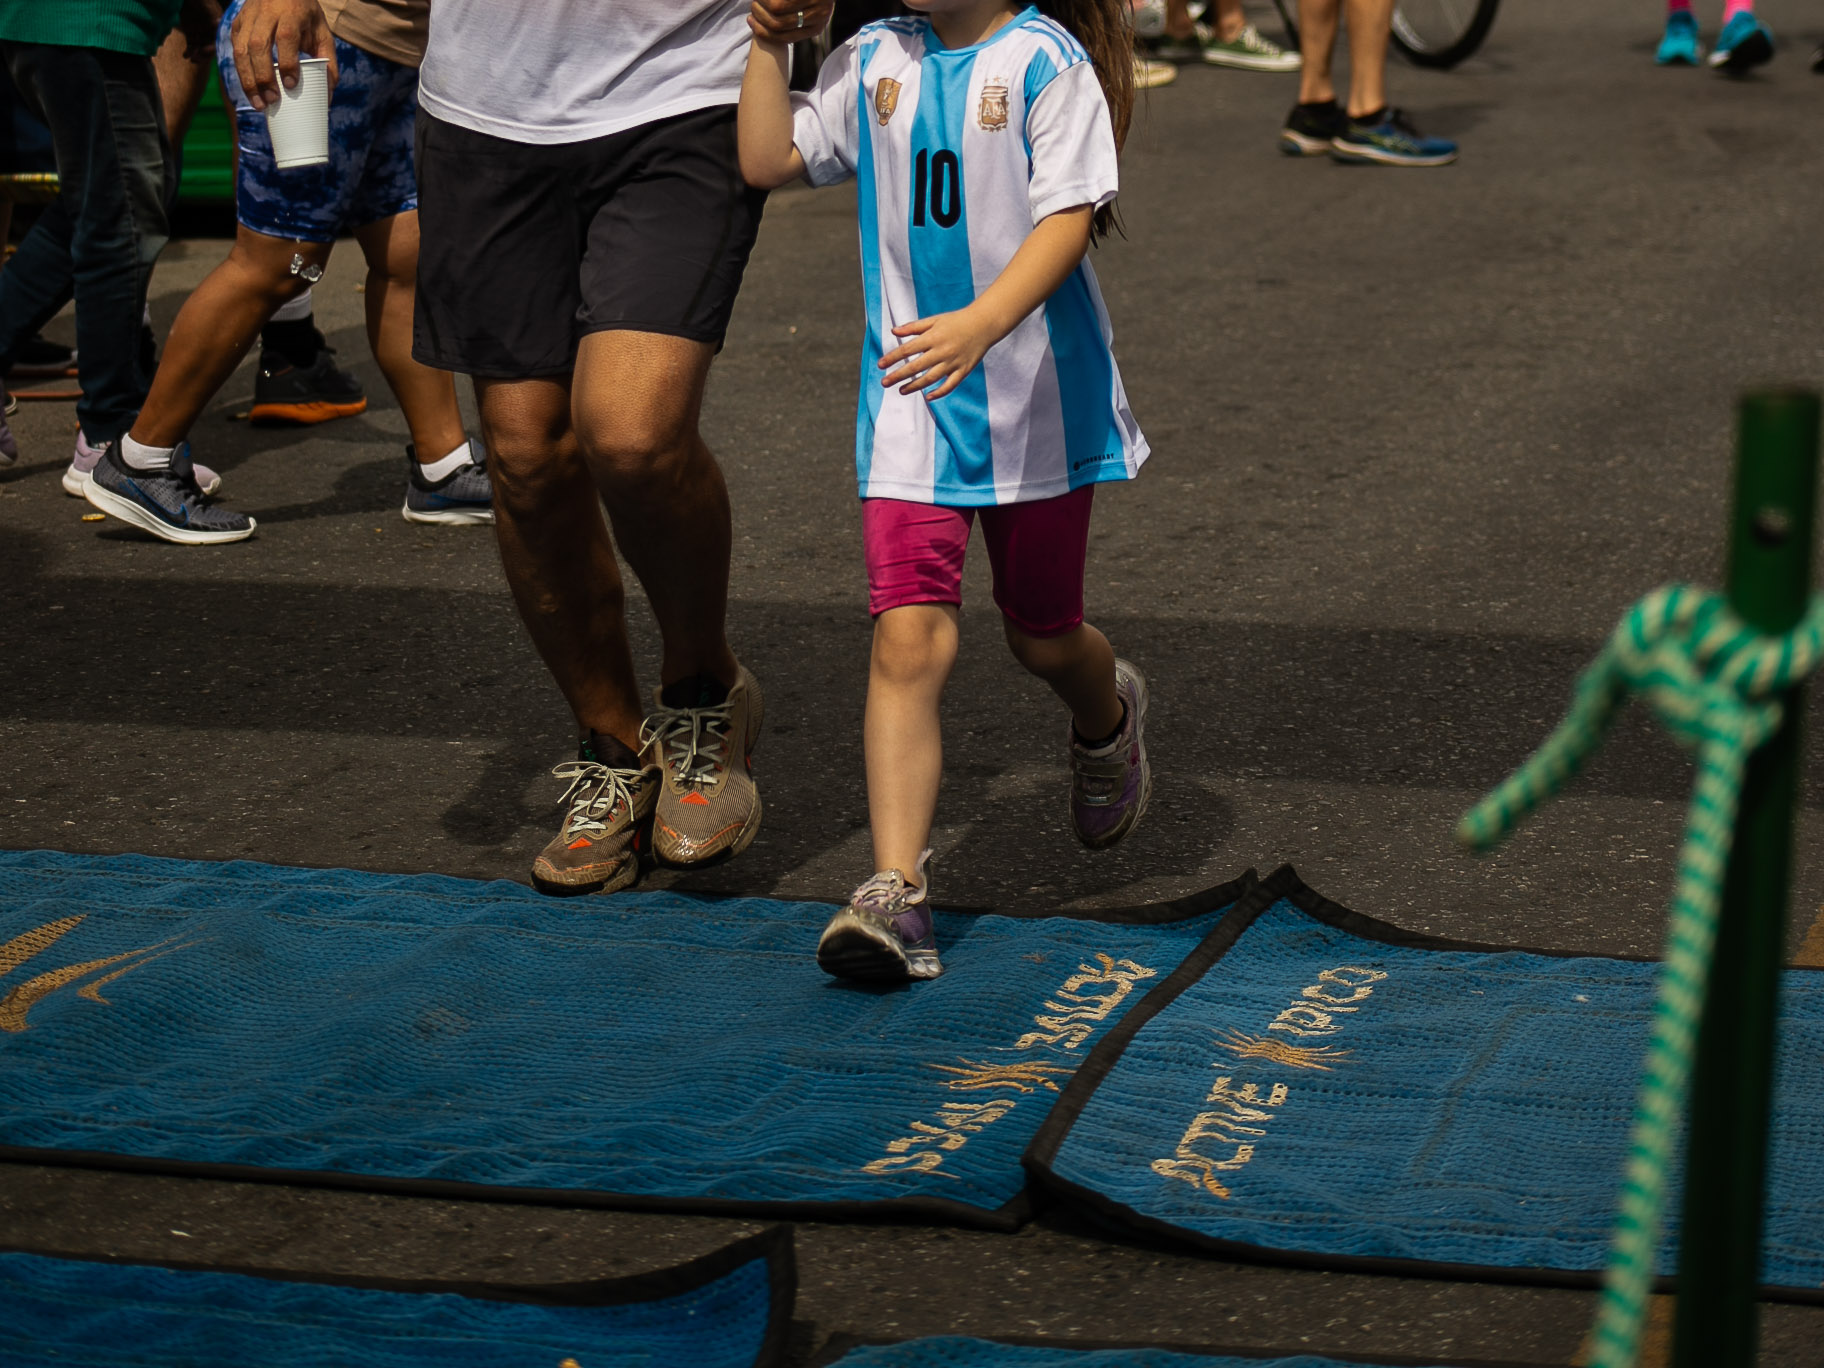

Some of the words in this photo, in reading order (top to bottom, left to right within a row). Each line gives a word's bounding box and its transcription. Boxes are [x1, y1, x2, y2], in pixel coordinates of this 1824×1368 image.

[913, 148, 961, 228] 10
[1149, 1075, 1290, 1200] ACTIVE
[1266, 964, 1389, 1038] IPICO
